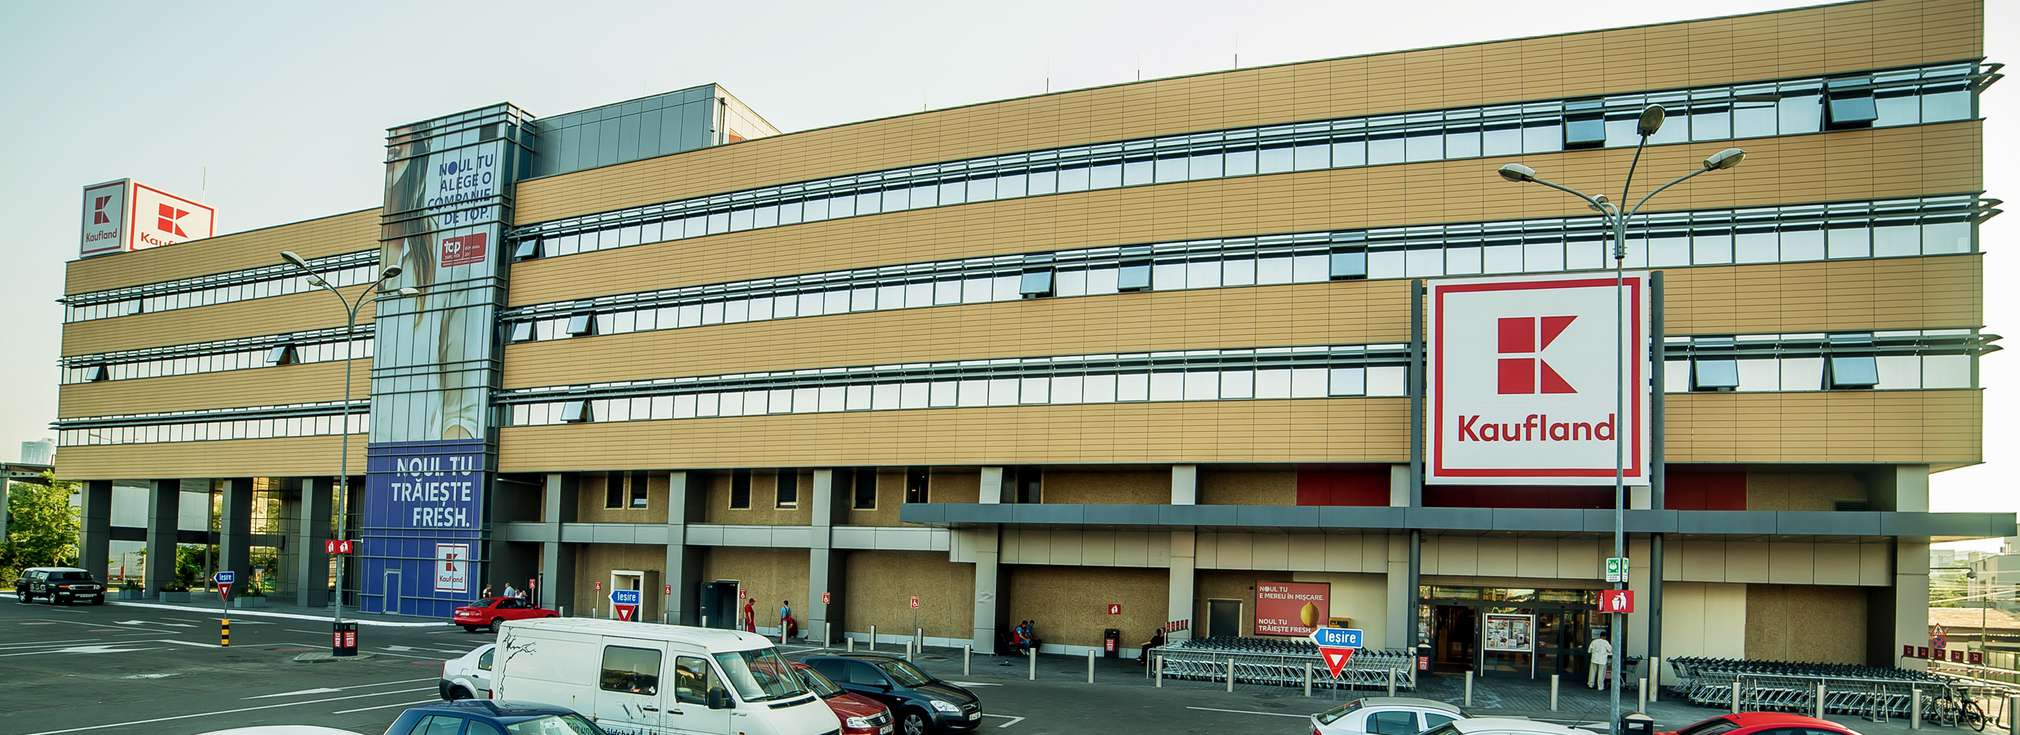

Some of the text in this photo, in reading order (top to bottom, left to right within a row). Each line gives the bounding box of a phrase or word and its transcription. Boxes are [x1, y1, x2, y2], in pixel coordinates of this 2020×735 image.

[439, 153, 494, 176] NOUL TU
[440, 171, 492, 192] ALEGE O
[428, 188, 491, 211] COMPANIE
[444, 211, 460, 226] DE
[86, 227, 118, 243] Kaufland
[1458, 413, 1616, 442] Kaufland
[397, 456, 473, 477] NOUL TU
[391, 477, 472, 507] TRĂIEȘTE
[412, 507, 470, 527] FRESH.
